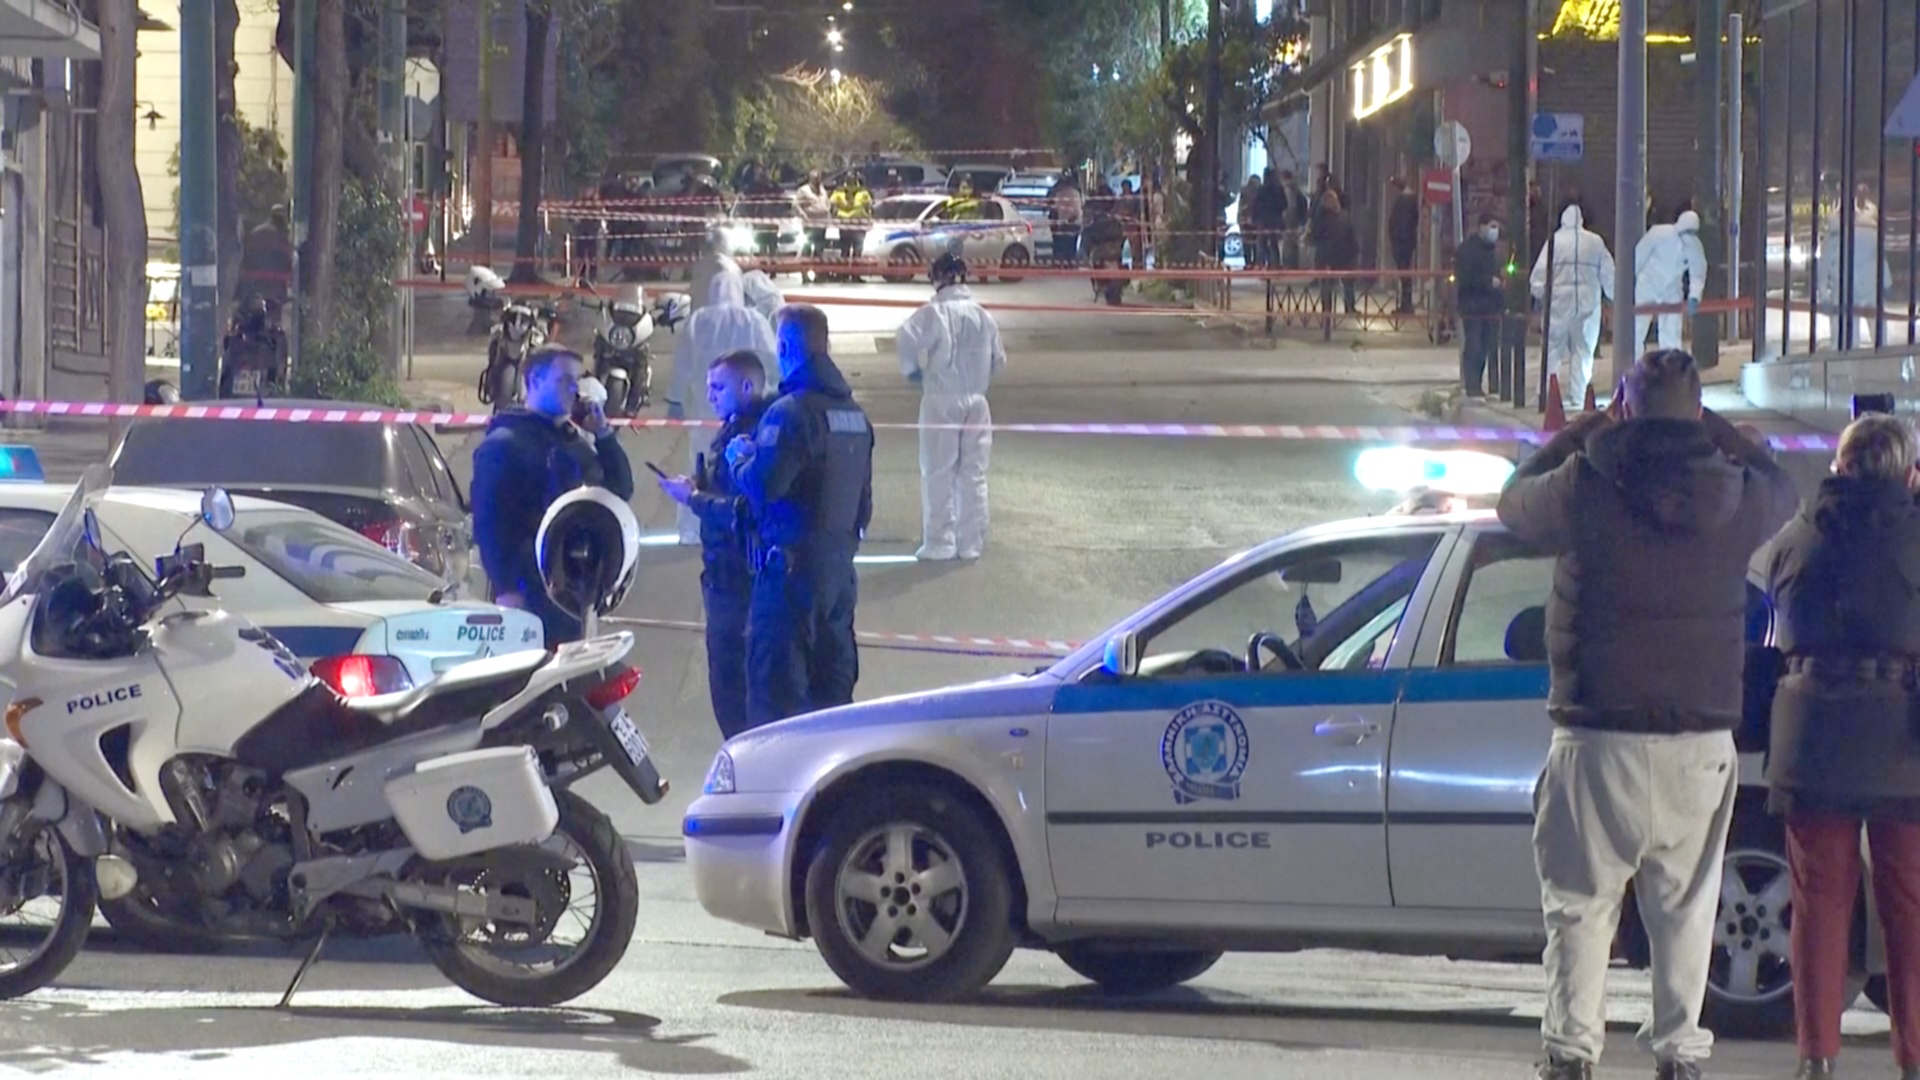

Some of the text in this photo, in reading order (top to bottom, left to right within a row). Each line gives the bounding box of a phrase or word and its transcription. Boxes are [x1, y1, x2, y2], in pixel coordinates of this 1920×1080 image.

[457, 625, 506, 642] POLICE
[66, 683, 143, 715] POLICE
[1145, 831, 1272, 849] POLICE
